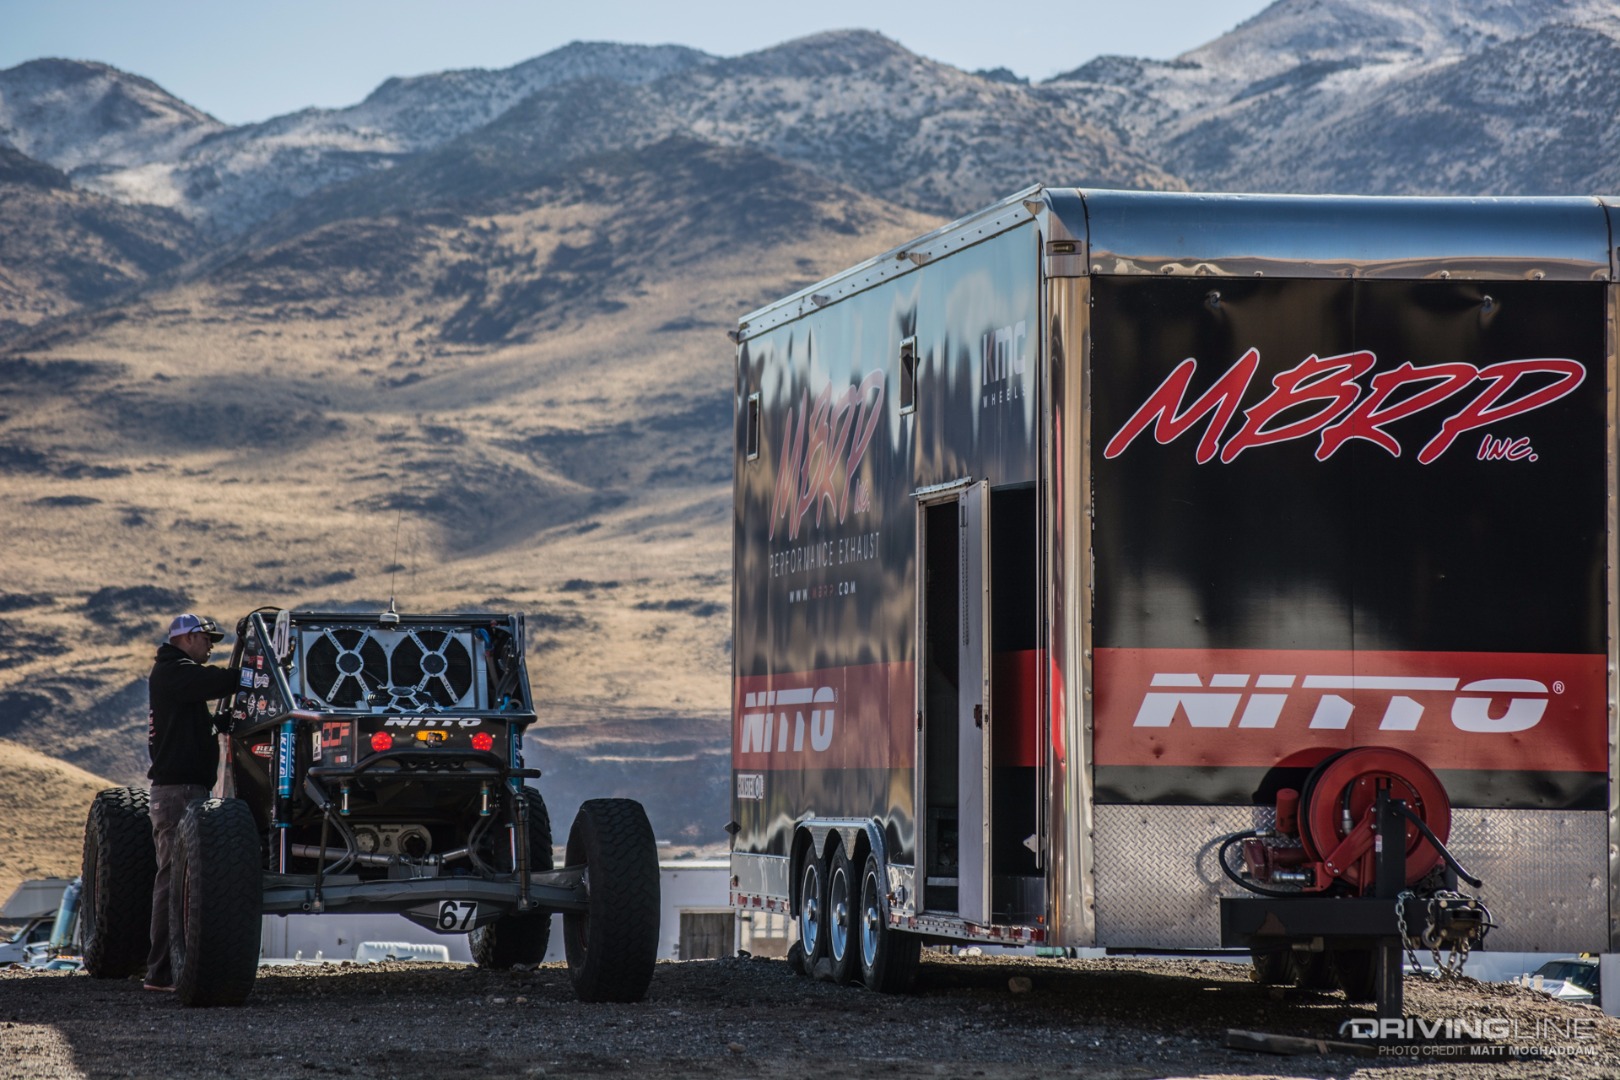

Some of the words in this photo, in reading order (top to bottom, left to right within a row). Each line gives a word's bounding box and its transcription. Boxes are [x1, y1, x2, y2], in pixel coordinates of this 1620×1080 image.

[1103, 347, 1586, 465] MBRP
[1476, 433, 1539, 463] INC.
[769, 368, 885, 541] MBRP
[769, 541, 834, 579] PERFORMANCE
[838, 531, 880, 565] EXHAUST
[384, 716, 481, 728] NITTO
[279, 736, 288, 777] KING
[438, 900, 477, 930] 67
